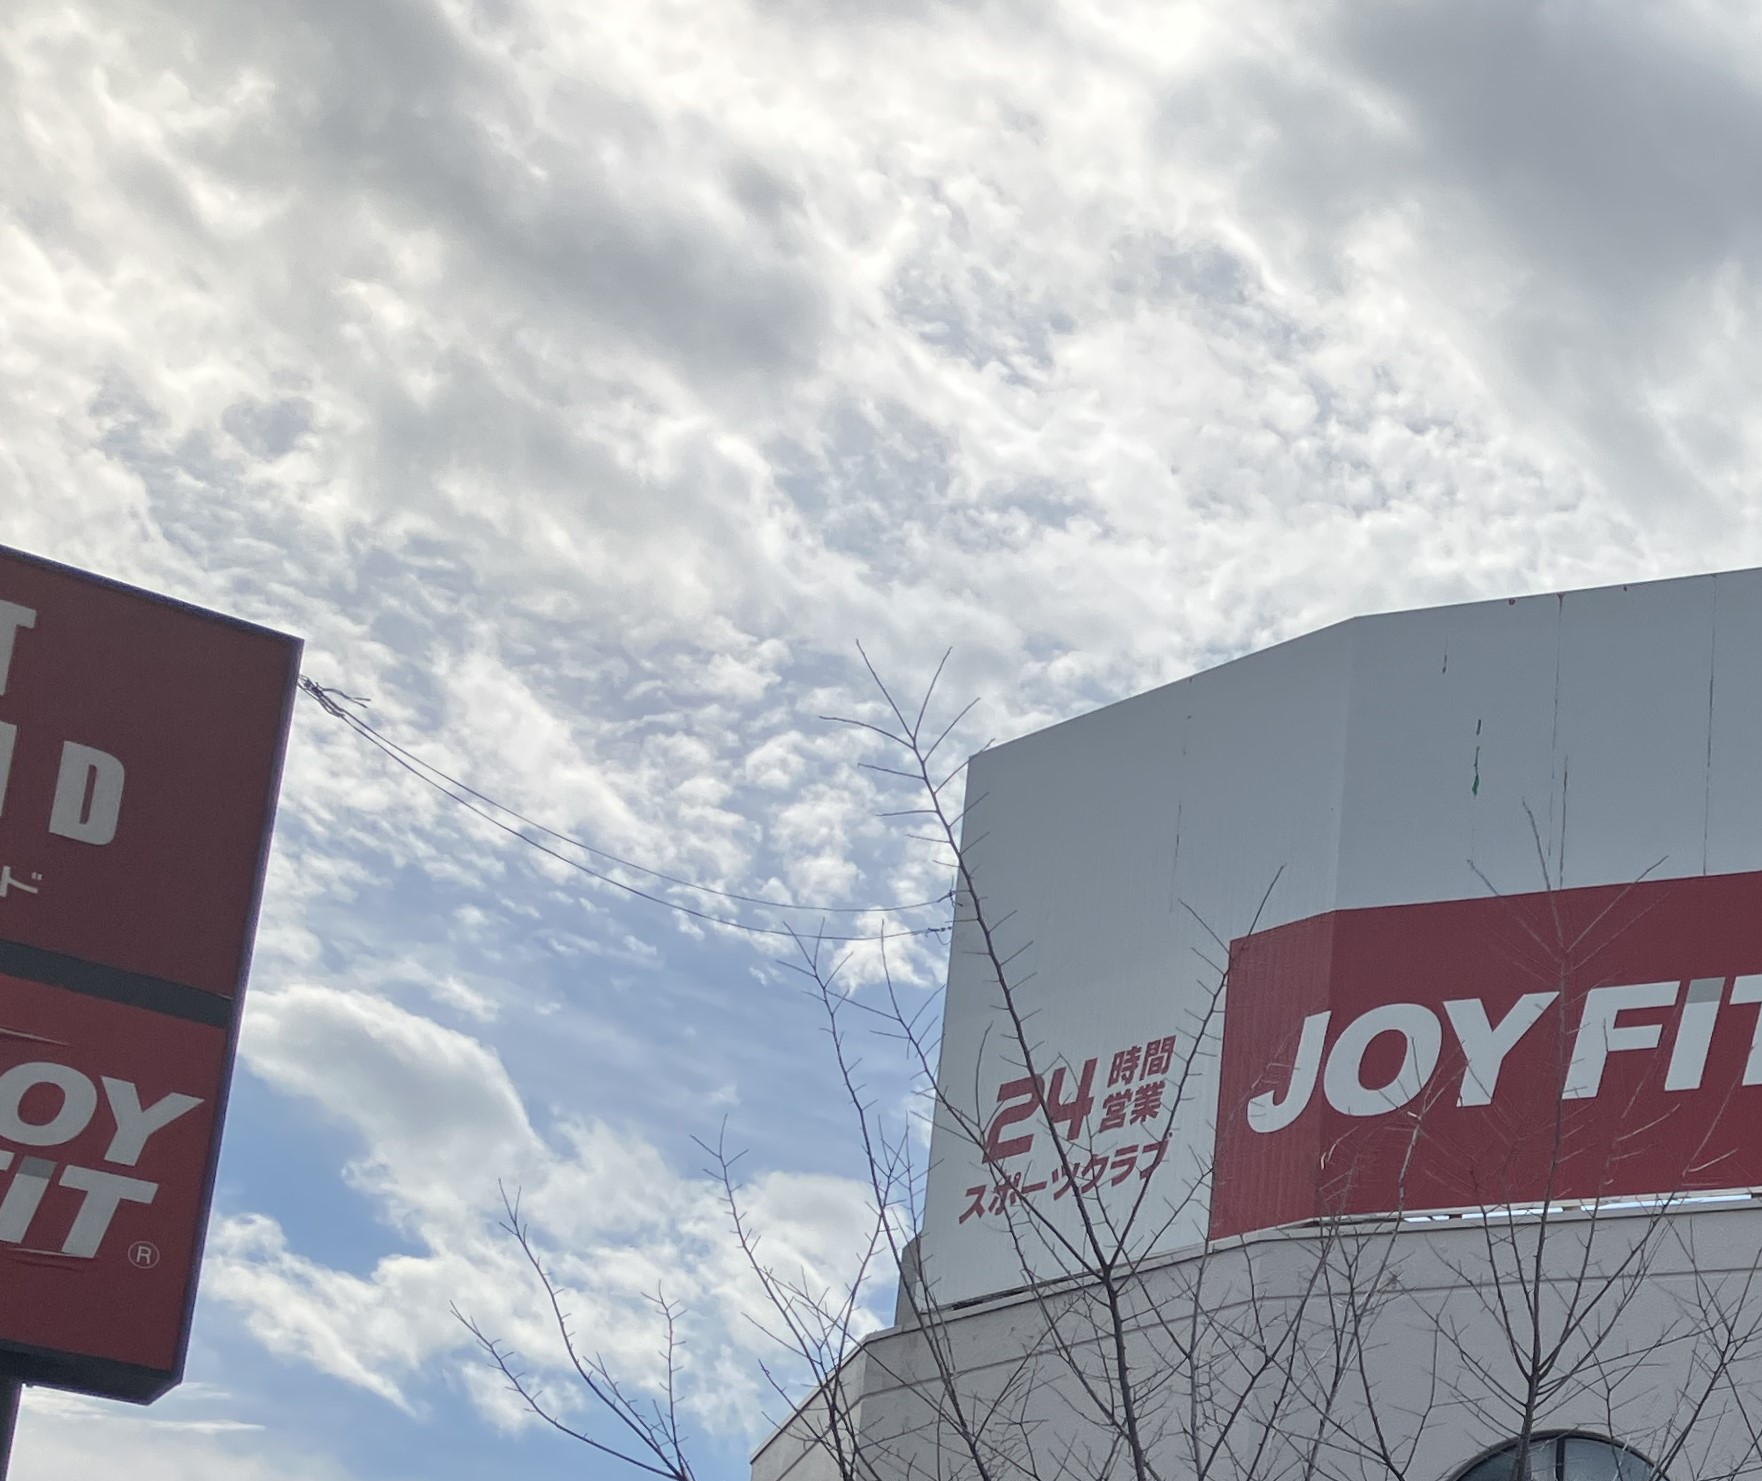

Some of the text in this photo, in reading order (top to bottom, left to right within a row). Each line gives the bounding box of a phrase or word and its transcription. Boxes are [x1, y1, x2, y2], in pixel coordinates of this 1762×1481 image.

[1099, 1080, 1166, 1133] 営業
[1107, 1034, 1177, 1088] 時間
[1247, 991, 1560, 1134] JOY
[981, 1057, 1098, 1164] 24
[959, 1131, 1173, 1224] スポーツクラブ
